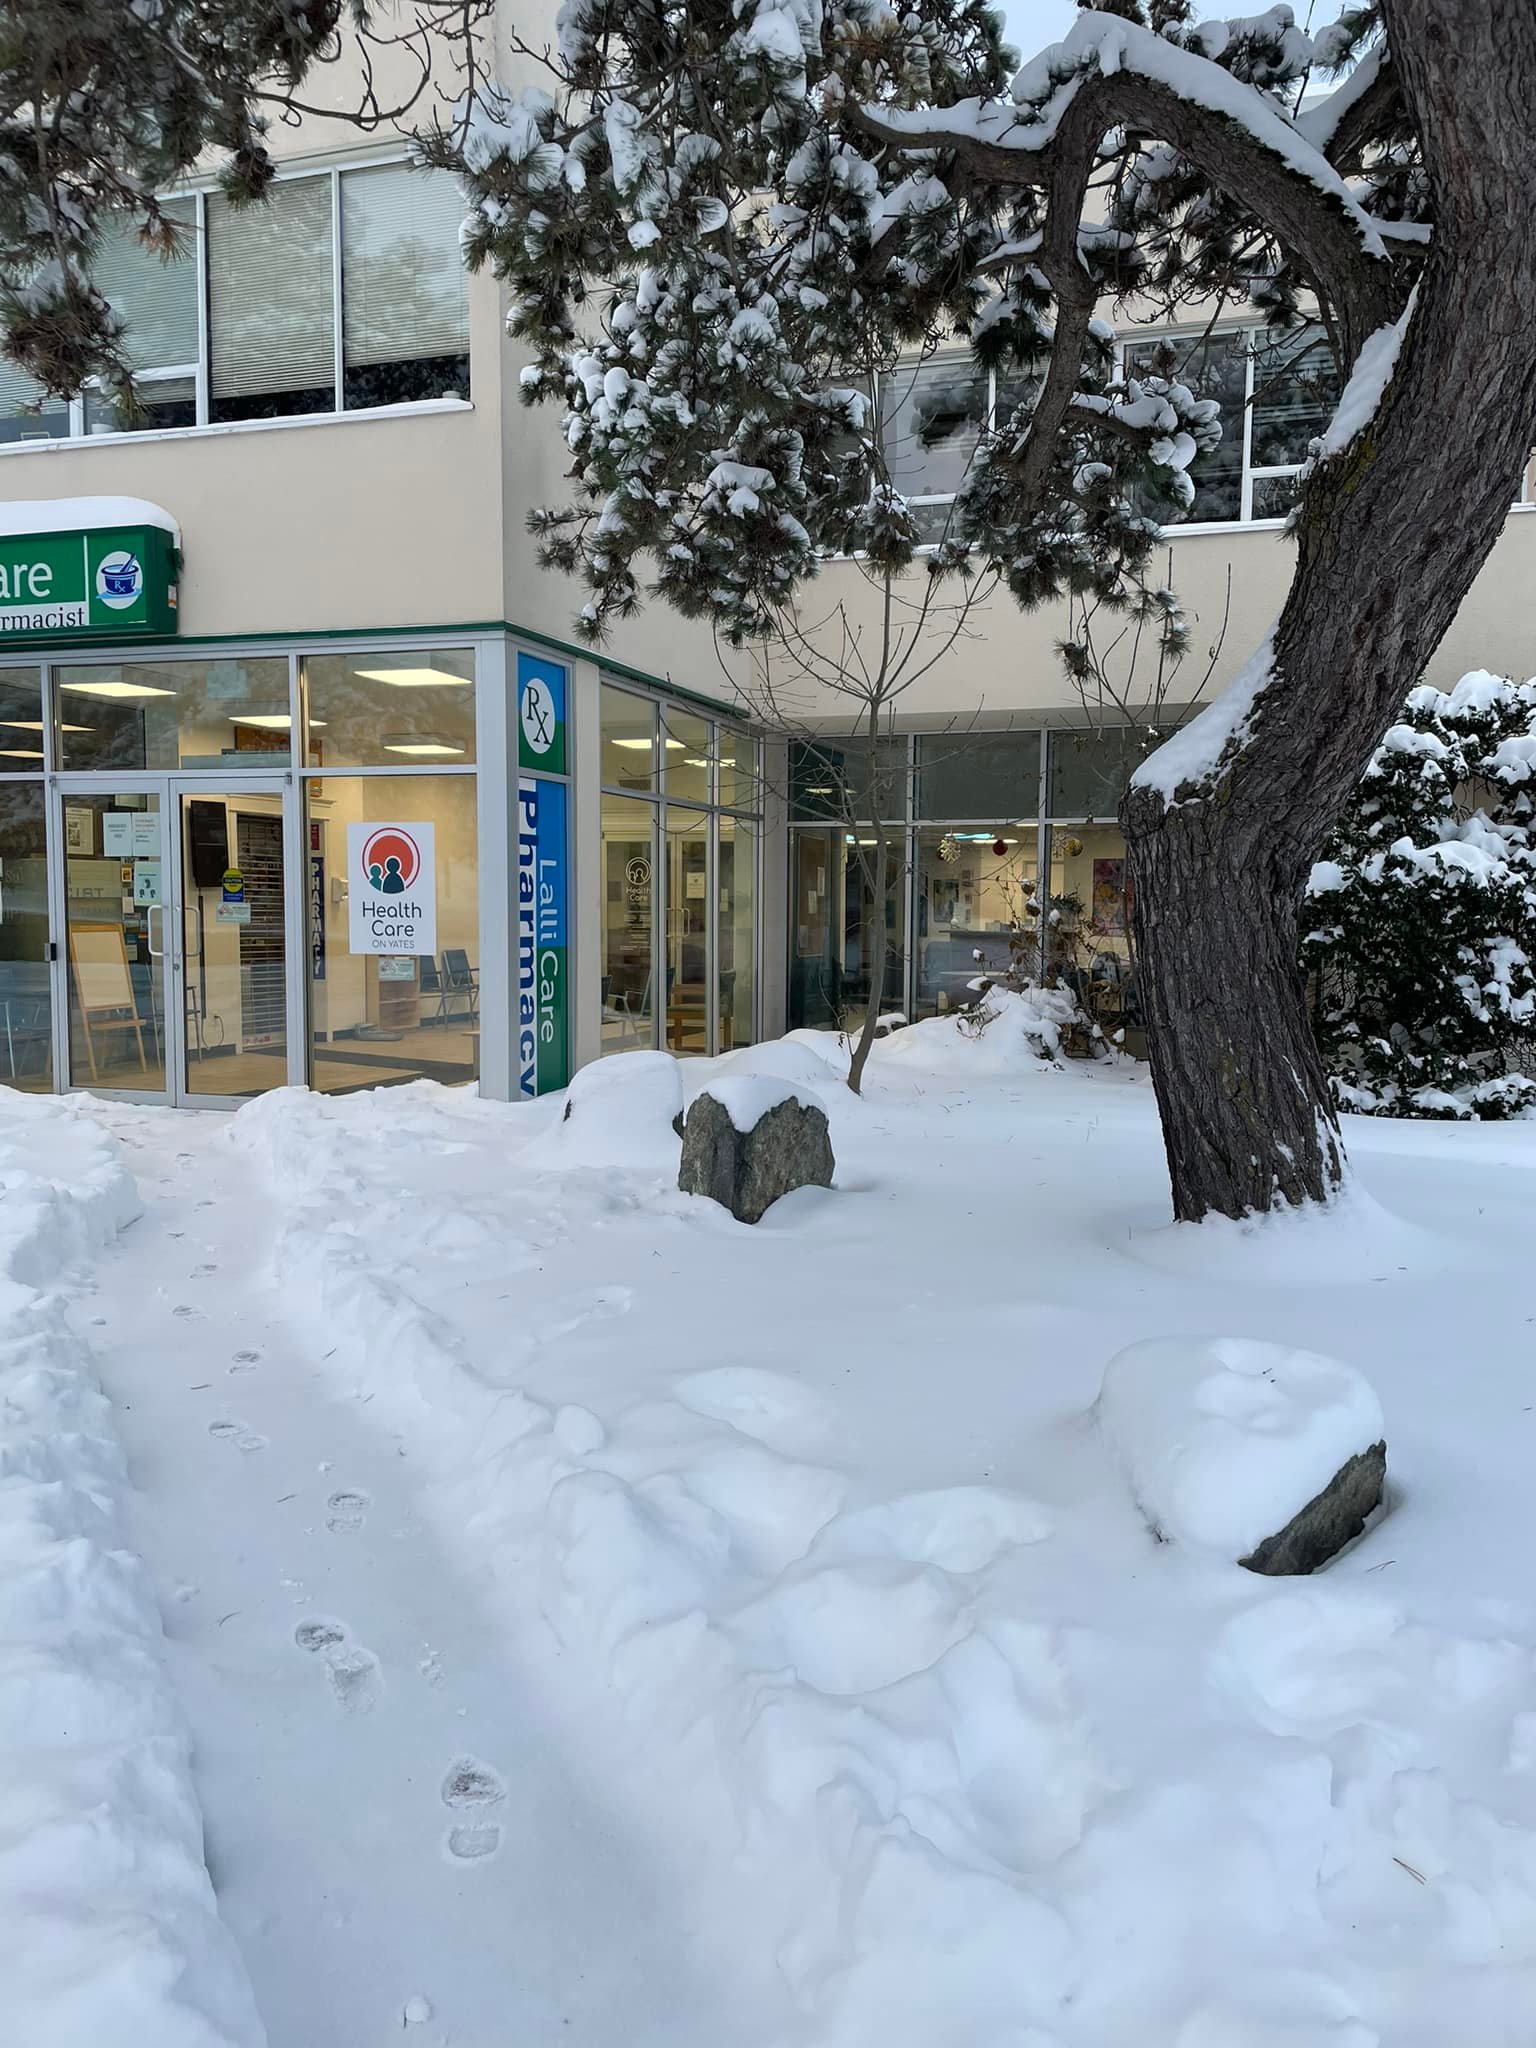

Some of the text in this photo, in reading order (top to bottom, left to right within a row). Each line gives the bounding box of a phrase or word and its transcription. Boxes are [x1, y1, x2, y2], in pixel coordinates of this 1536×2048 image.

[311, 862, 322, 976] PHARMACY
[362, 901, 422, 919] Health
[371, 919, 415, 937] Care
[371, 939, 415, 949] ON YATES
[539, 859, 558, 1043] Lalli Care
